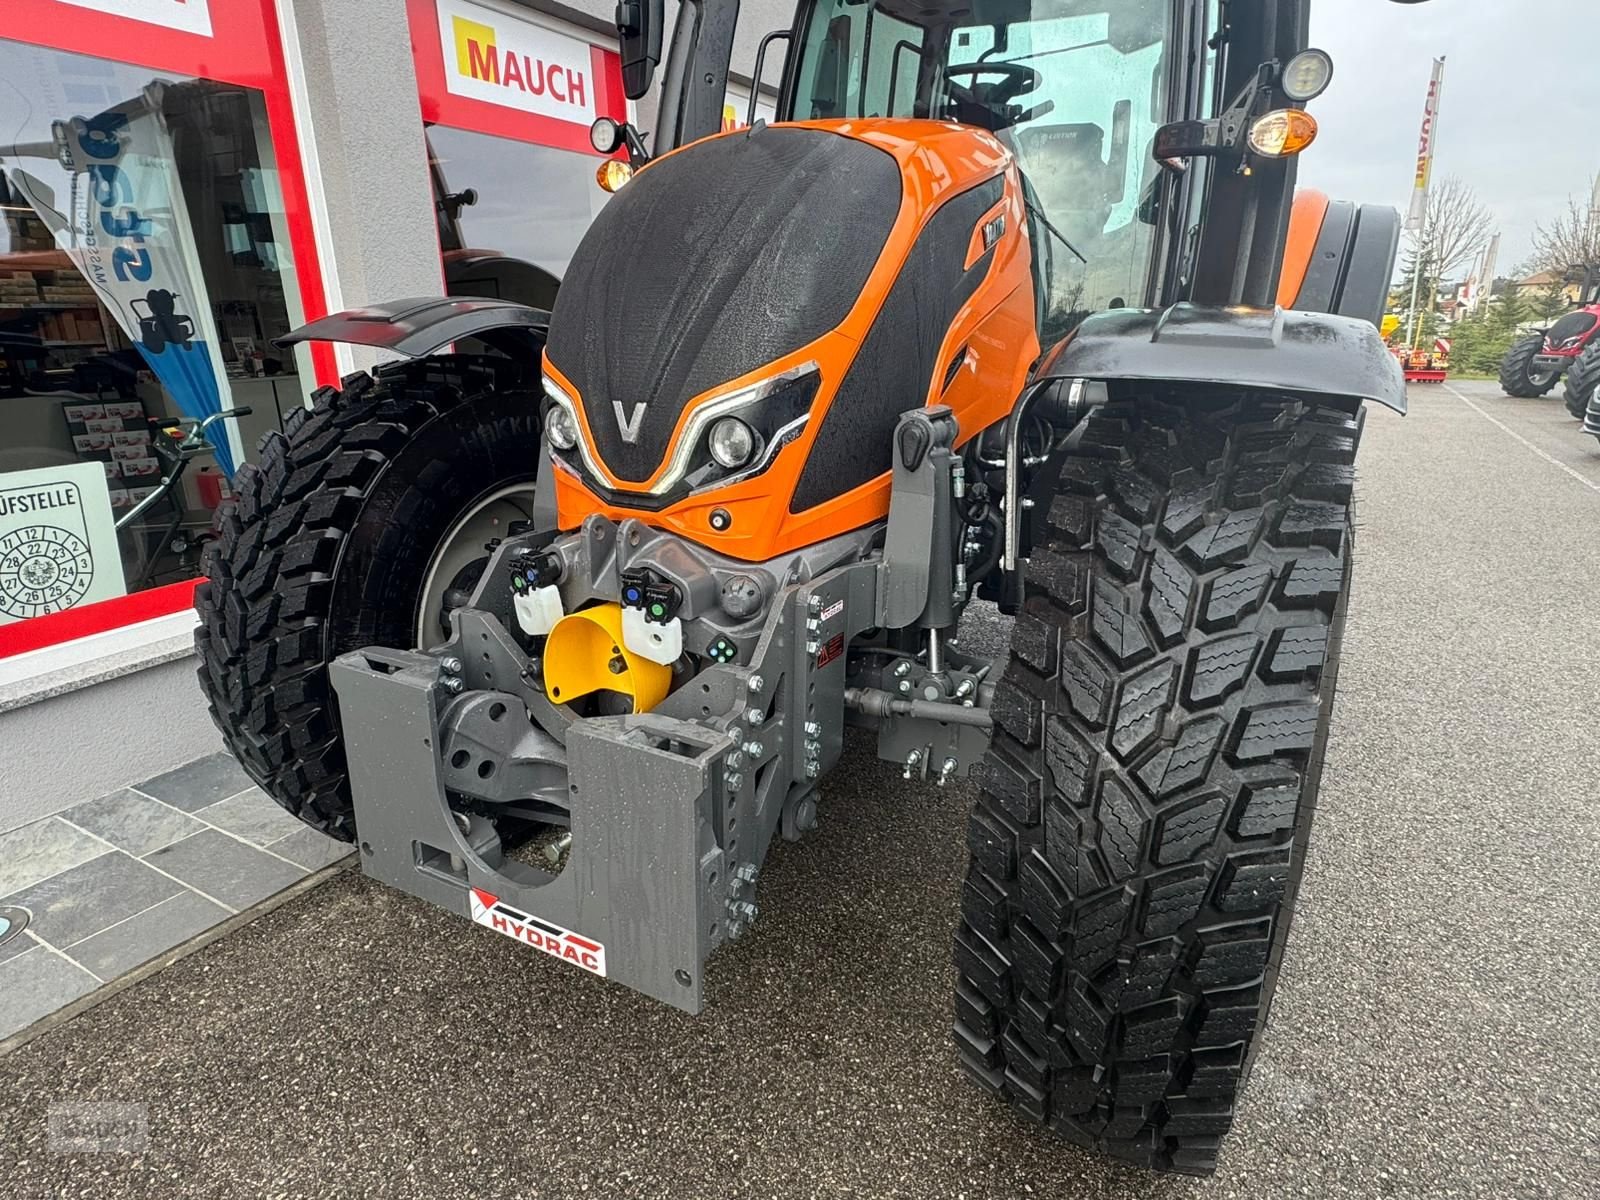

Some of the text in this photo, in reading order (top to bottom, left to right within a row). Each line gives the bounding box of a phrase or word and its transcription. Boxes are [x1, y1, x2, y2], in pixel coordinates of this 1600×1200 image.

[467, 38, 586, 107] MAUCH
[25, 529, 38, 540] 12
[53, 531, 58, 541] 1
[2, 538, 13, 550] 11
[27, 543, 42, 555] 22
[71, 541, 79, 552] 2
[52, 547, 66, 560] 23
[6, 556, 20, 569] 28
[80, 558, 88, 569] 3
[61, 566, 75, 578] 24
[5, 578, 17, 590] 27
[78, 577, 85, 588] 4
[25, 591, 40, 603] 26
[49, 585, 63, 597] 25
[65, 594, 73, 605] 5
[19, 605, 26, 616] 7
[43, 604, 51, 615] 6
[492, 913, 599, 971] HYDRAC
